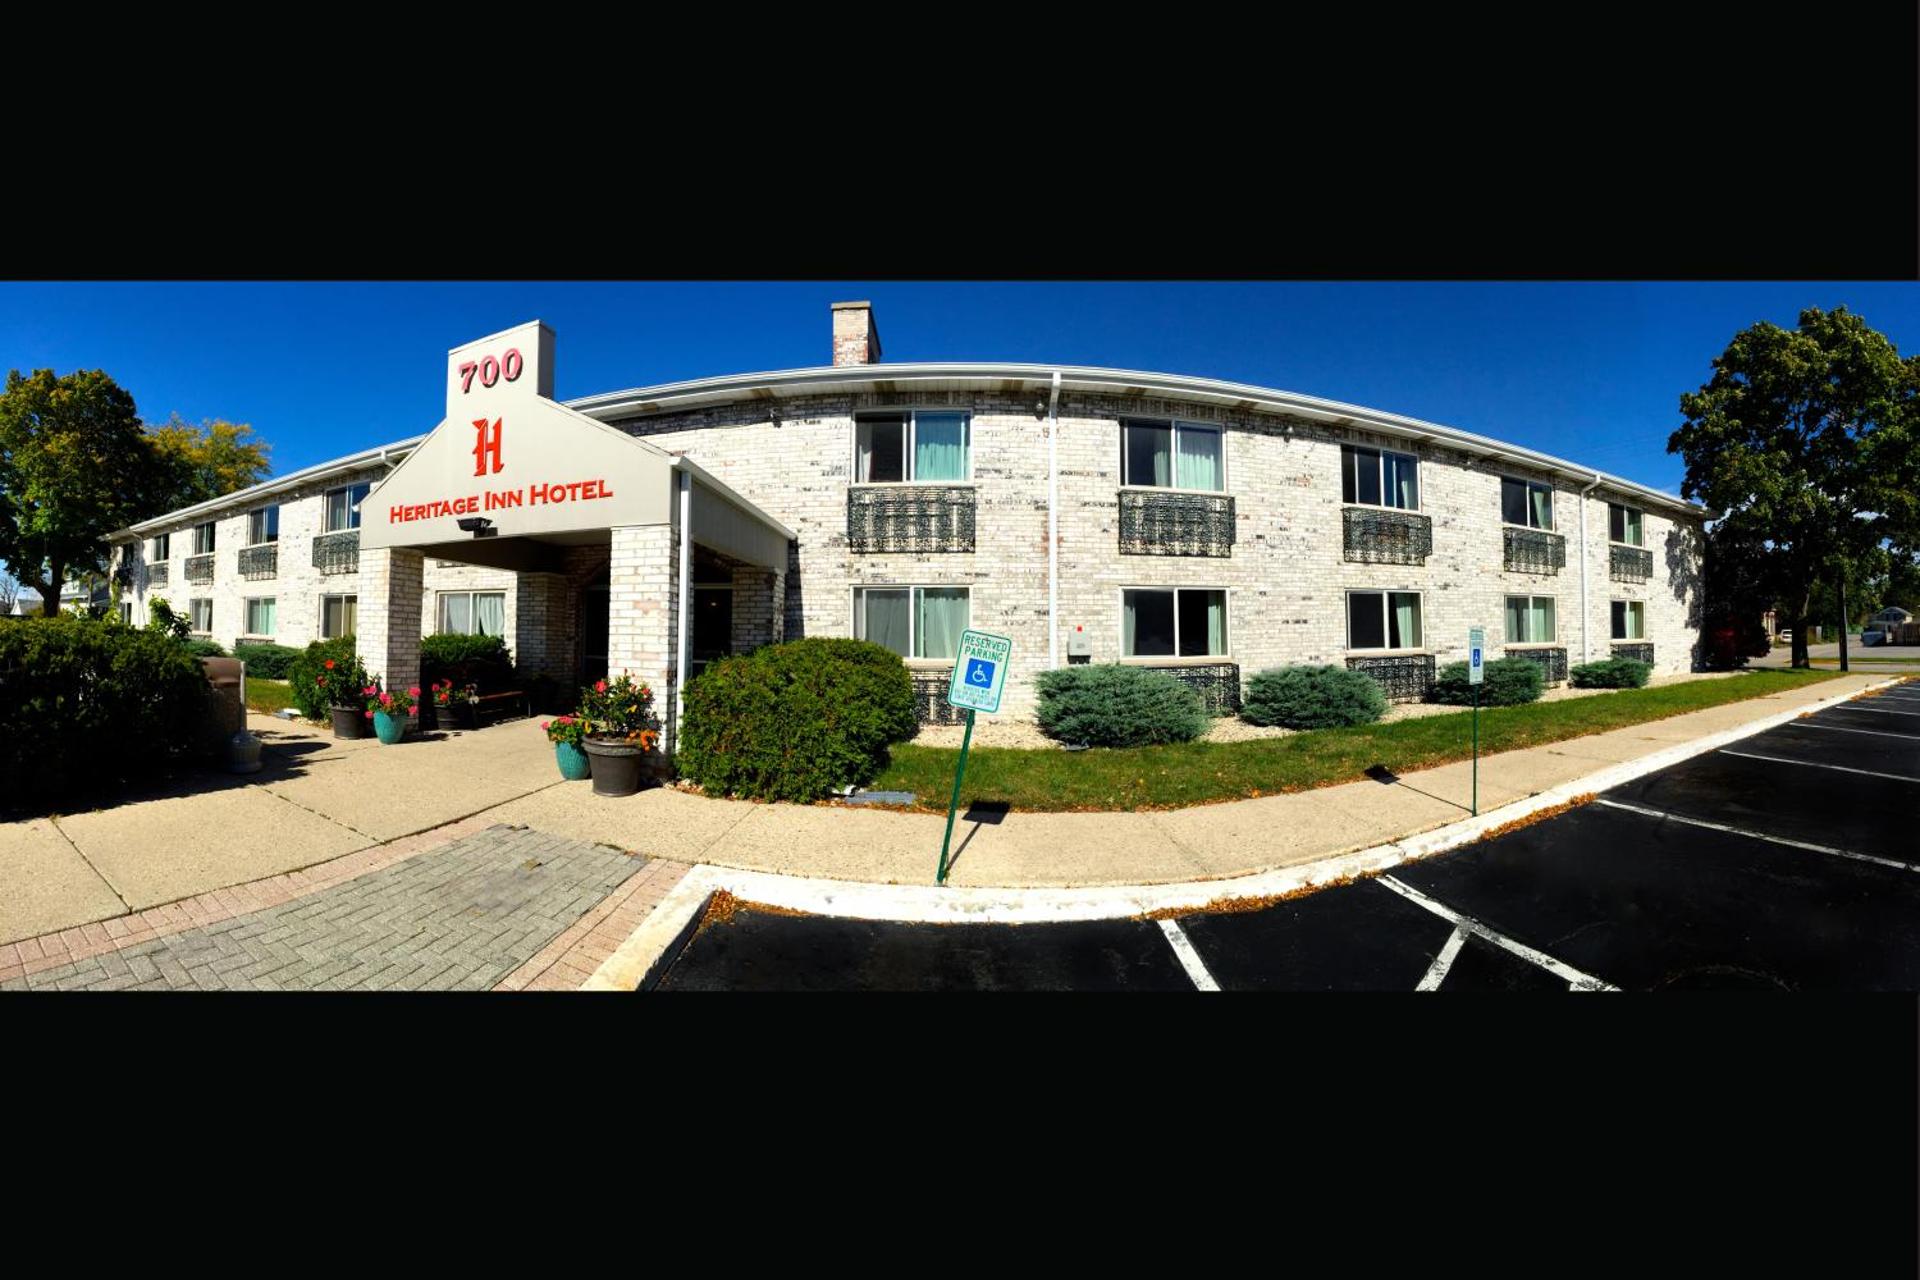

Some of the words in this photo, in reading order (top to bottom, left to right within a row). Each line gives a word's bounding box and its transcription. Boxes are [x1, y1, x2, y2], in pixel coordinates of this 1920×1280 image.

[458, 348, 523, 394] 700
[472, 417, 505, 477] H
[389, 496, 479, 524] HERITAGE
[484, 489, 523, 511] INN
[529, 479, 614, 506] HOTEL
[964, 635, 1008, 653] RESERVED
[964, 645, 1004, 662] PARKING
